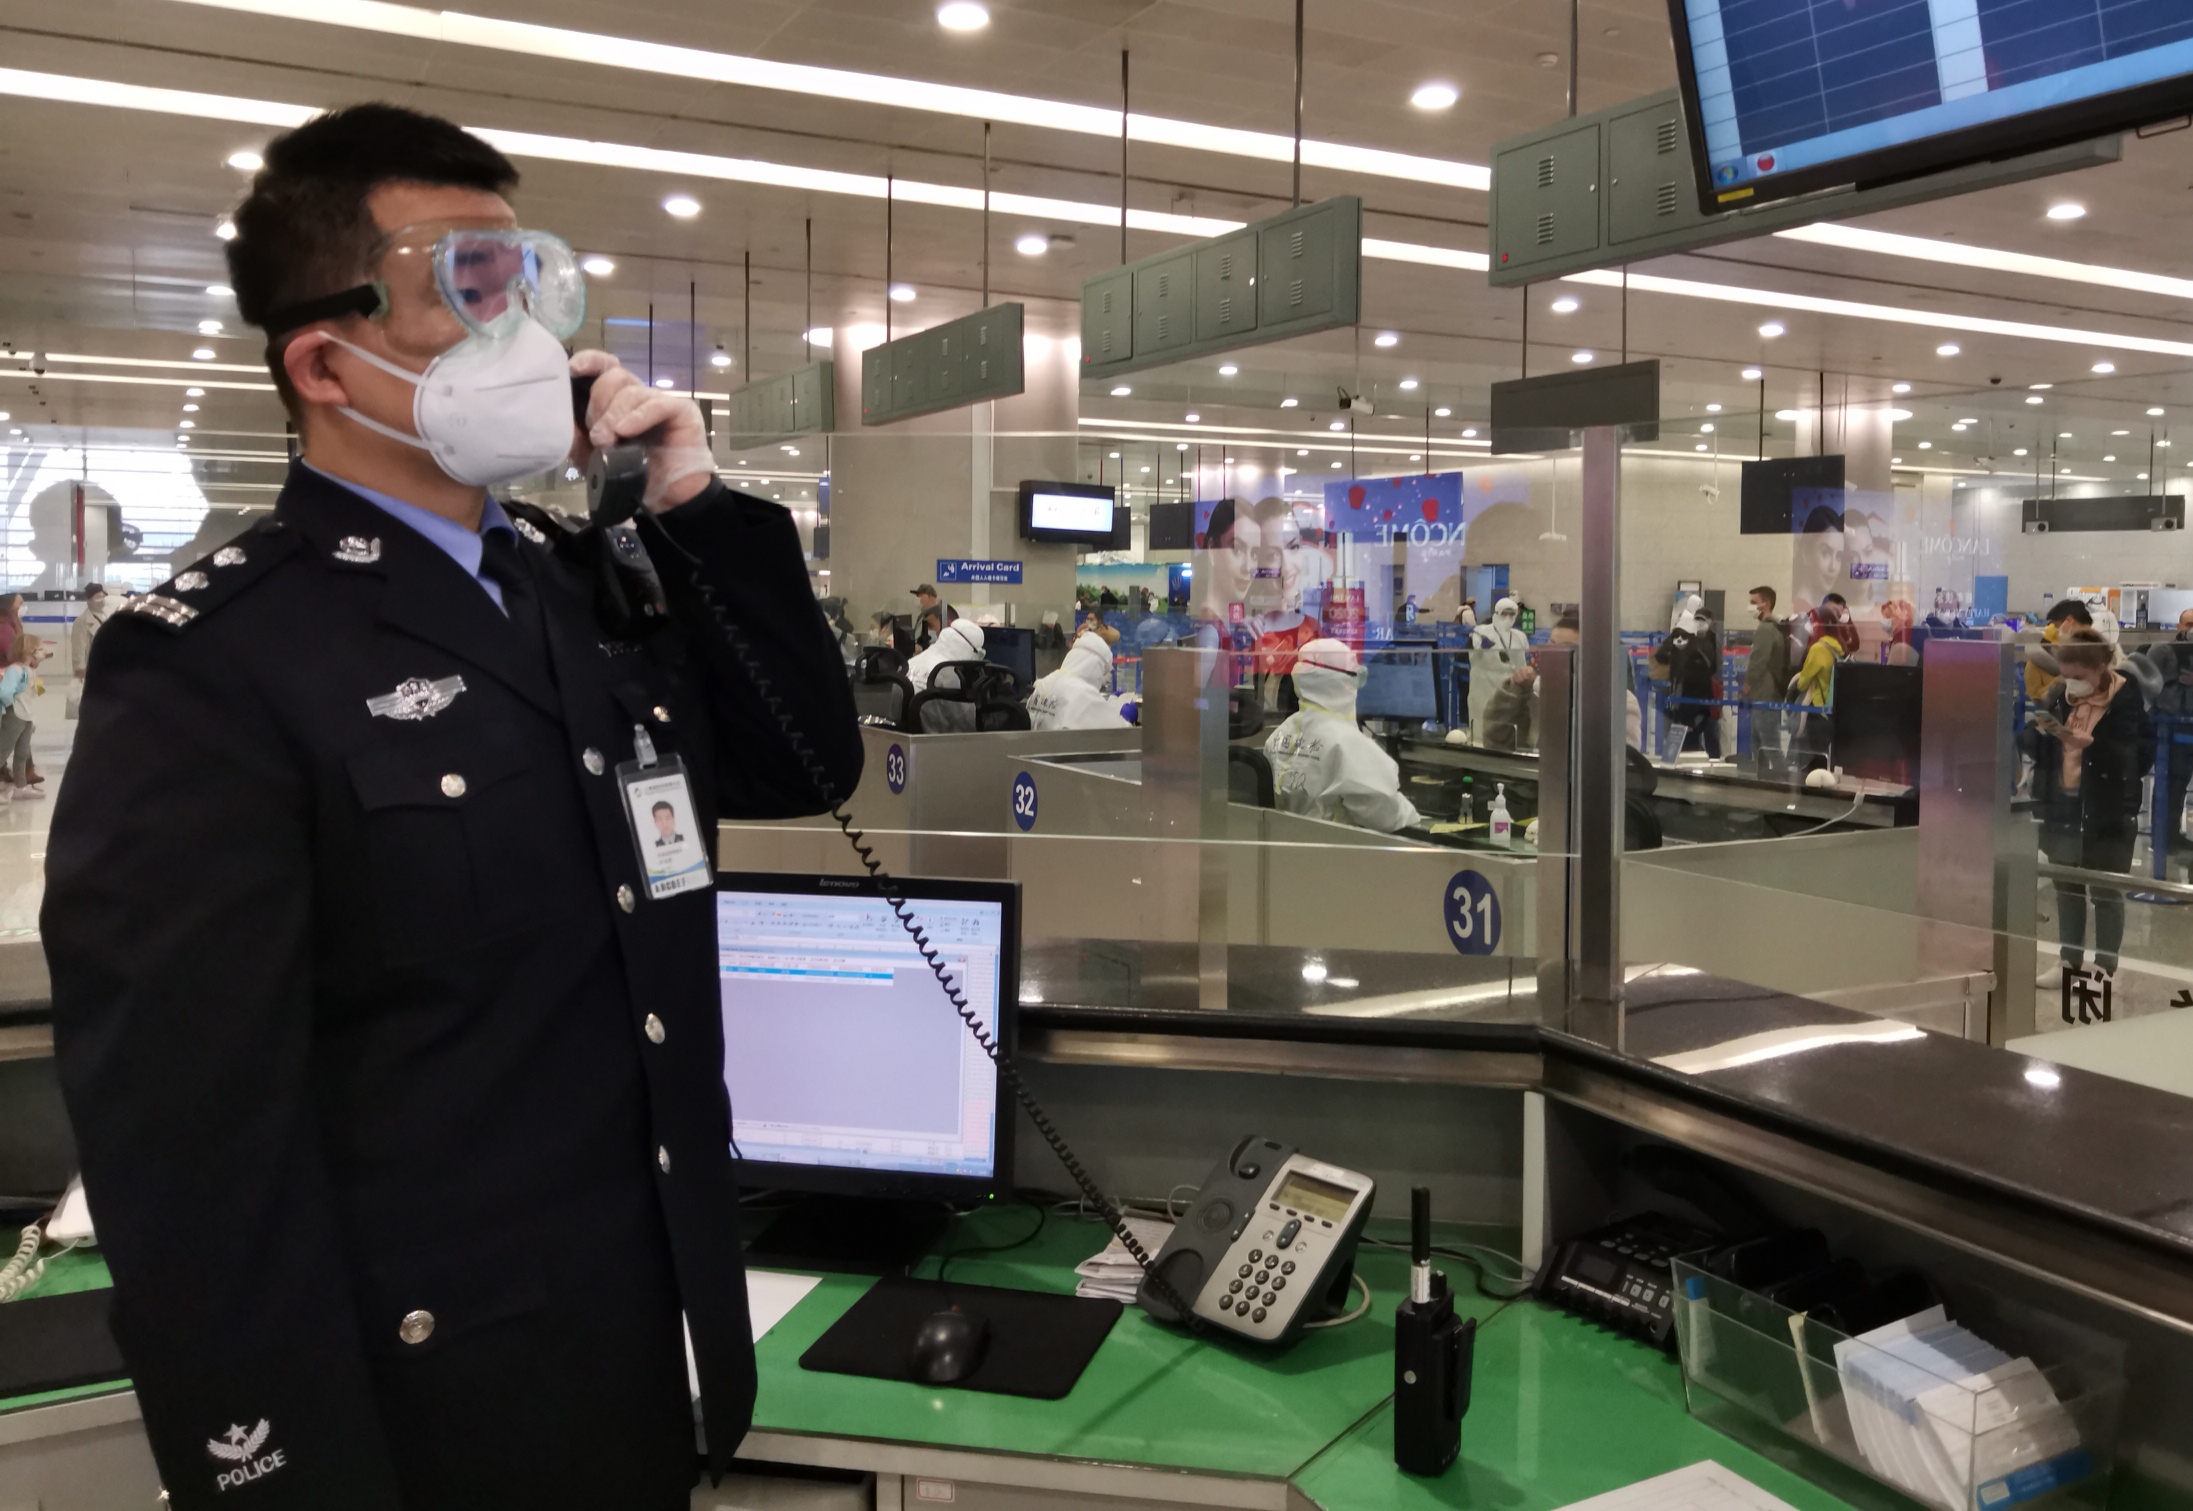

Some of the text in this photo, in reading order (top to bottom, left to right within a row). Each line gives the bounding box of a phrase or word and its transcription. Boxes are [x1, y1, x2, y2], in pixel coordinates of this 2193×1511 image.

[961, 562, 1020, 572] Arrival Card
[888, 753, 904, 786] 33
[1015, 784, 1035, 817] 32
[1453, 886, 1491, 945] 31
[217, 1449, 287, 1491] POLICE
